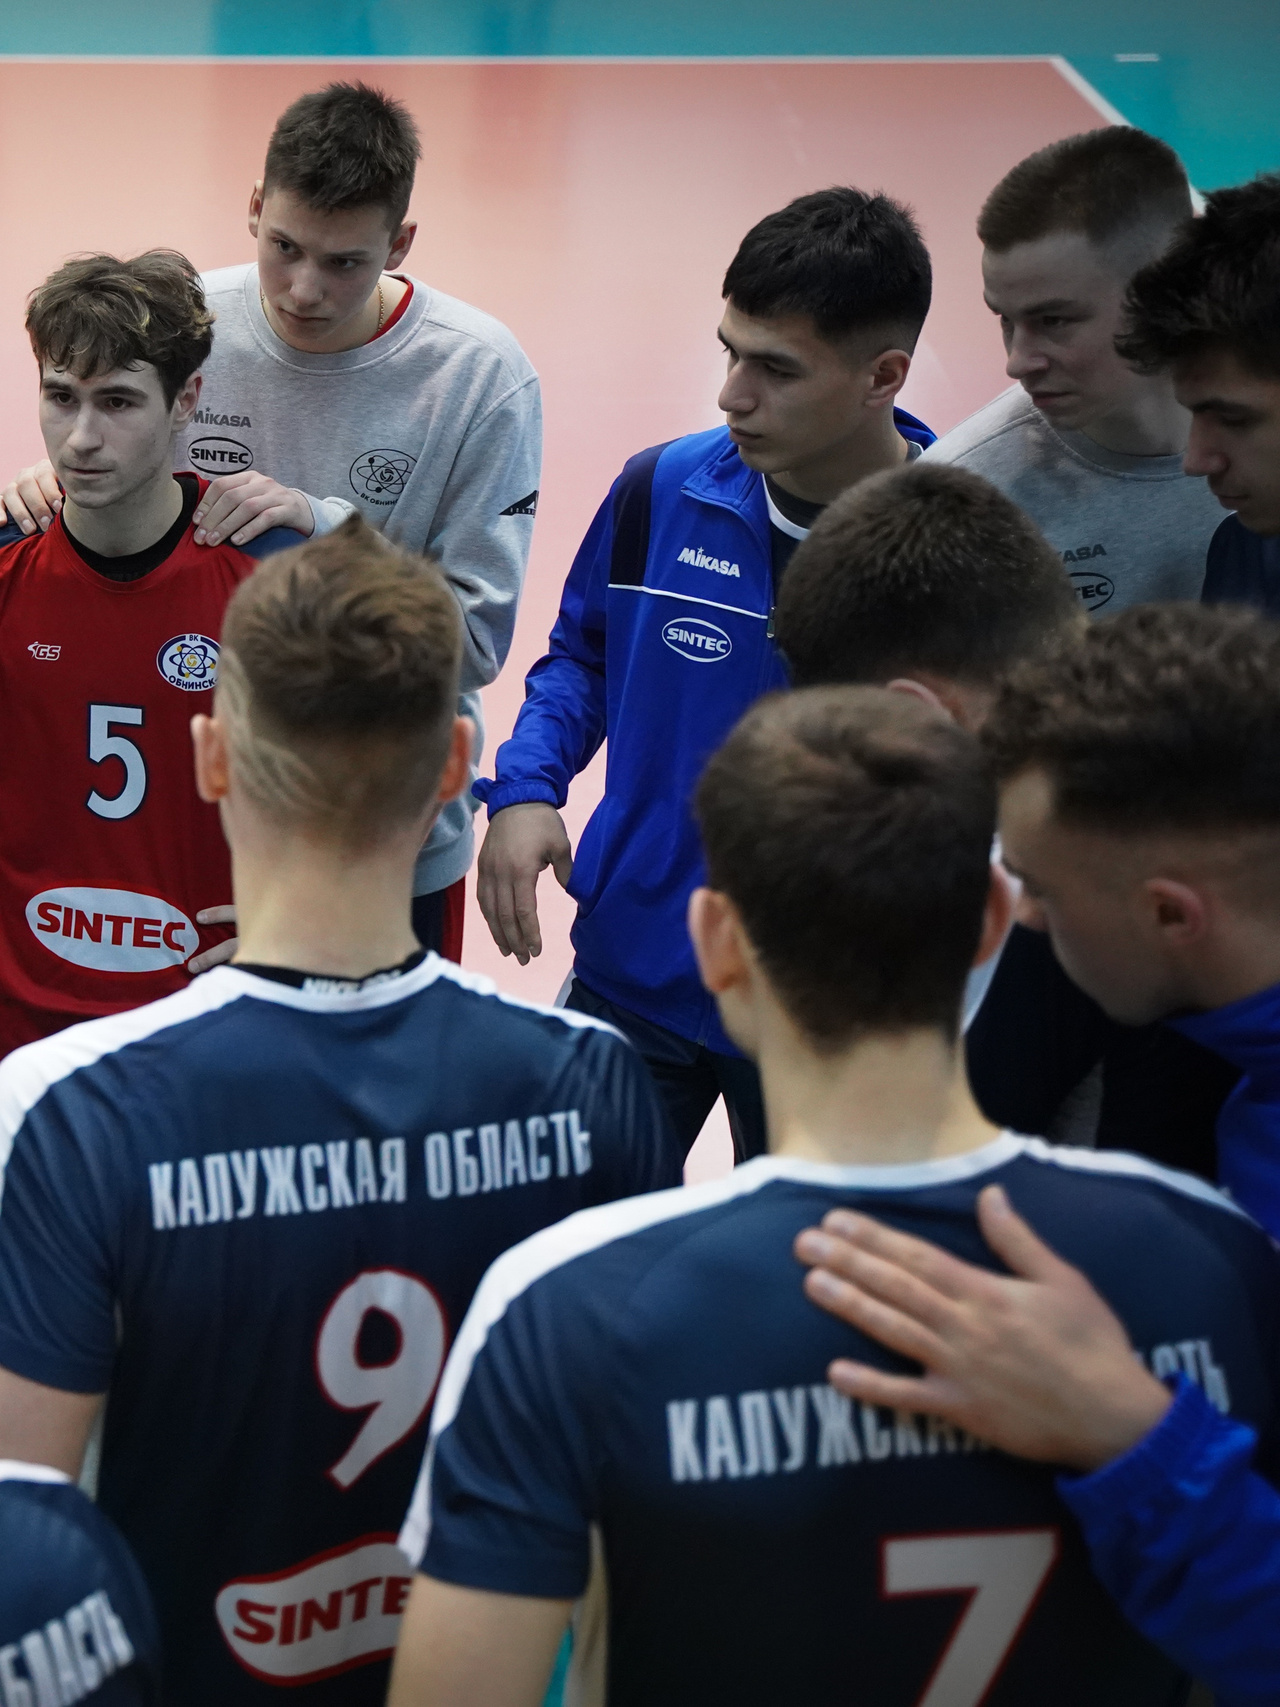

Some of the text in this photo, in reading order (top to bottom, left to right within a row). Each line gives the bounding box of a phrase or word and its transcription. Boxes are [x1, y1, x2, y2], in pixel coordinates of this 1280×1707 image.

[191, 448, 249, 464] SINTEC
[370, 498, 399, 506] ОБНИН
[189, 634, 199, 642] ВК
[666, 627, 728, 653] SINTEC
[168, 675, 217, 690] ОБНИНСК
[84, 702, 148, 821] 5
[36, 901, 187, 954] SINTEC
[148, 1109, 593, 1231] КАЛУЖСКАЯ ОБЛАСТЬ
[315, 1264, 450, 1492] 9
[232, 1575, 414, 1646] SINTE
[879, 1528, 1062, 1707] 7
